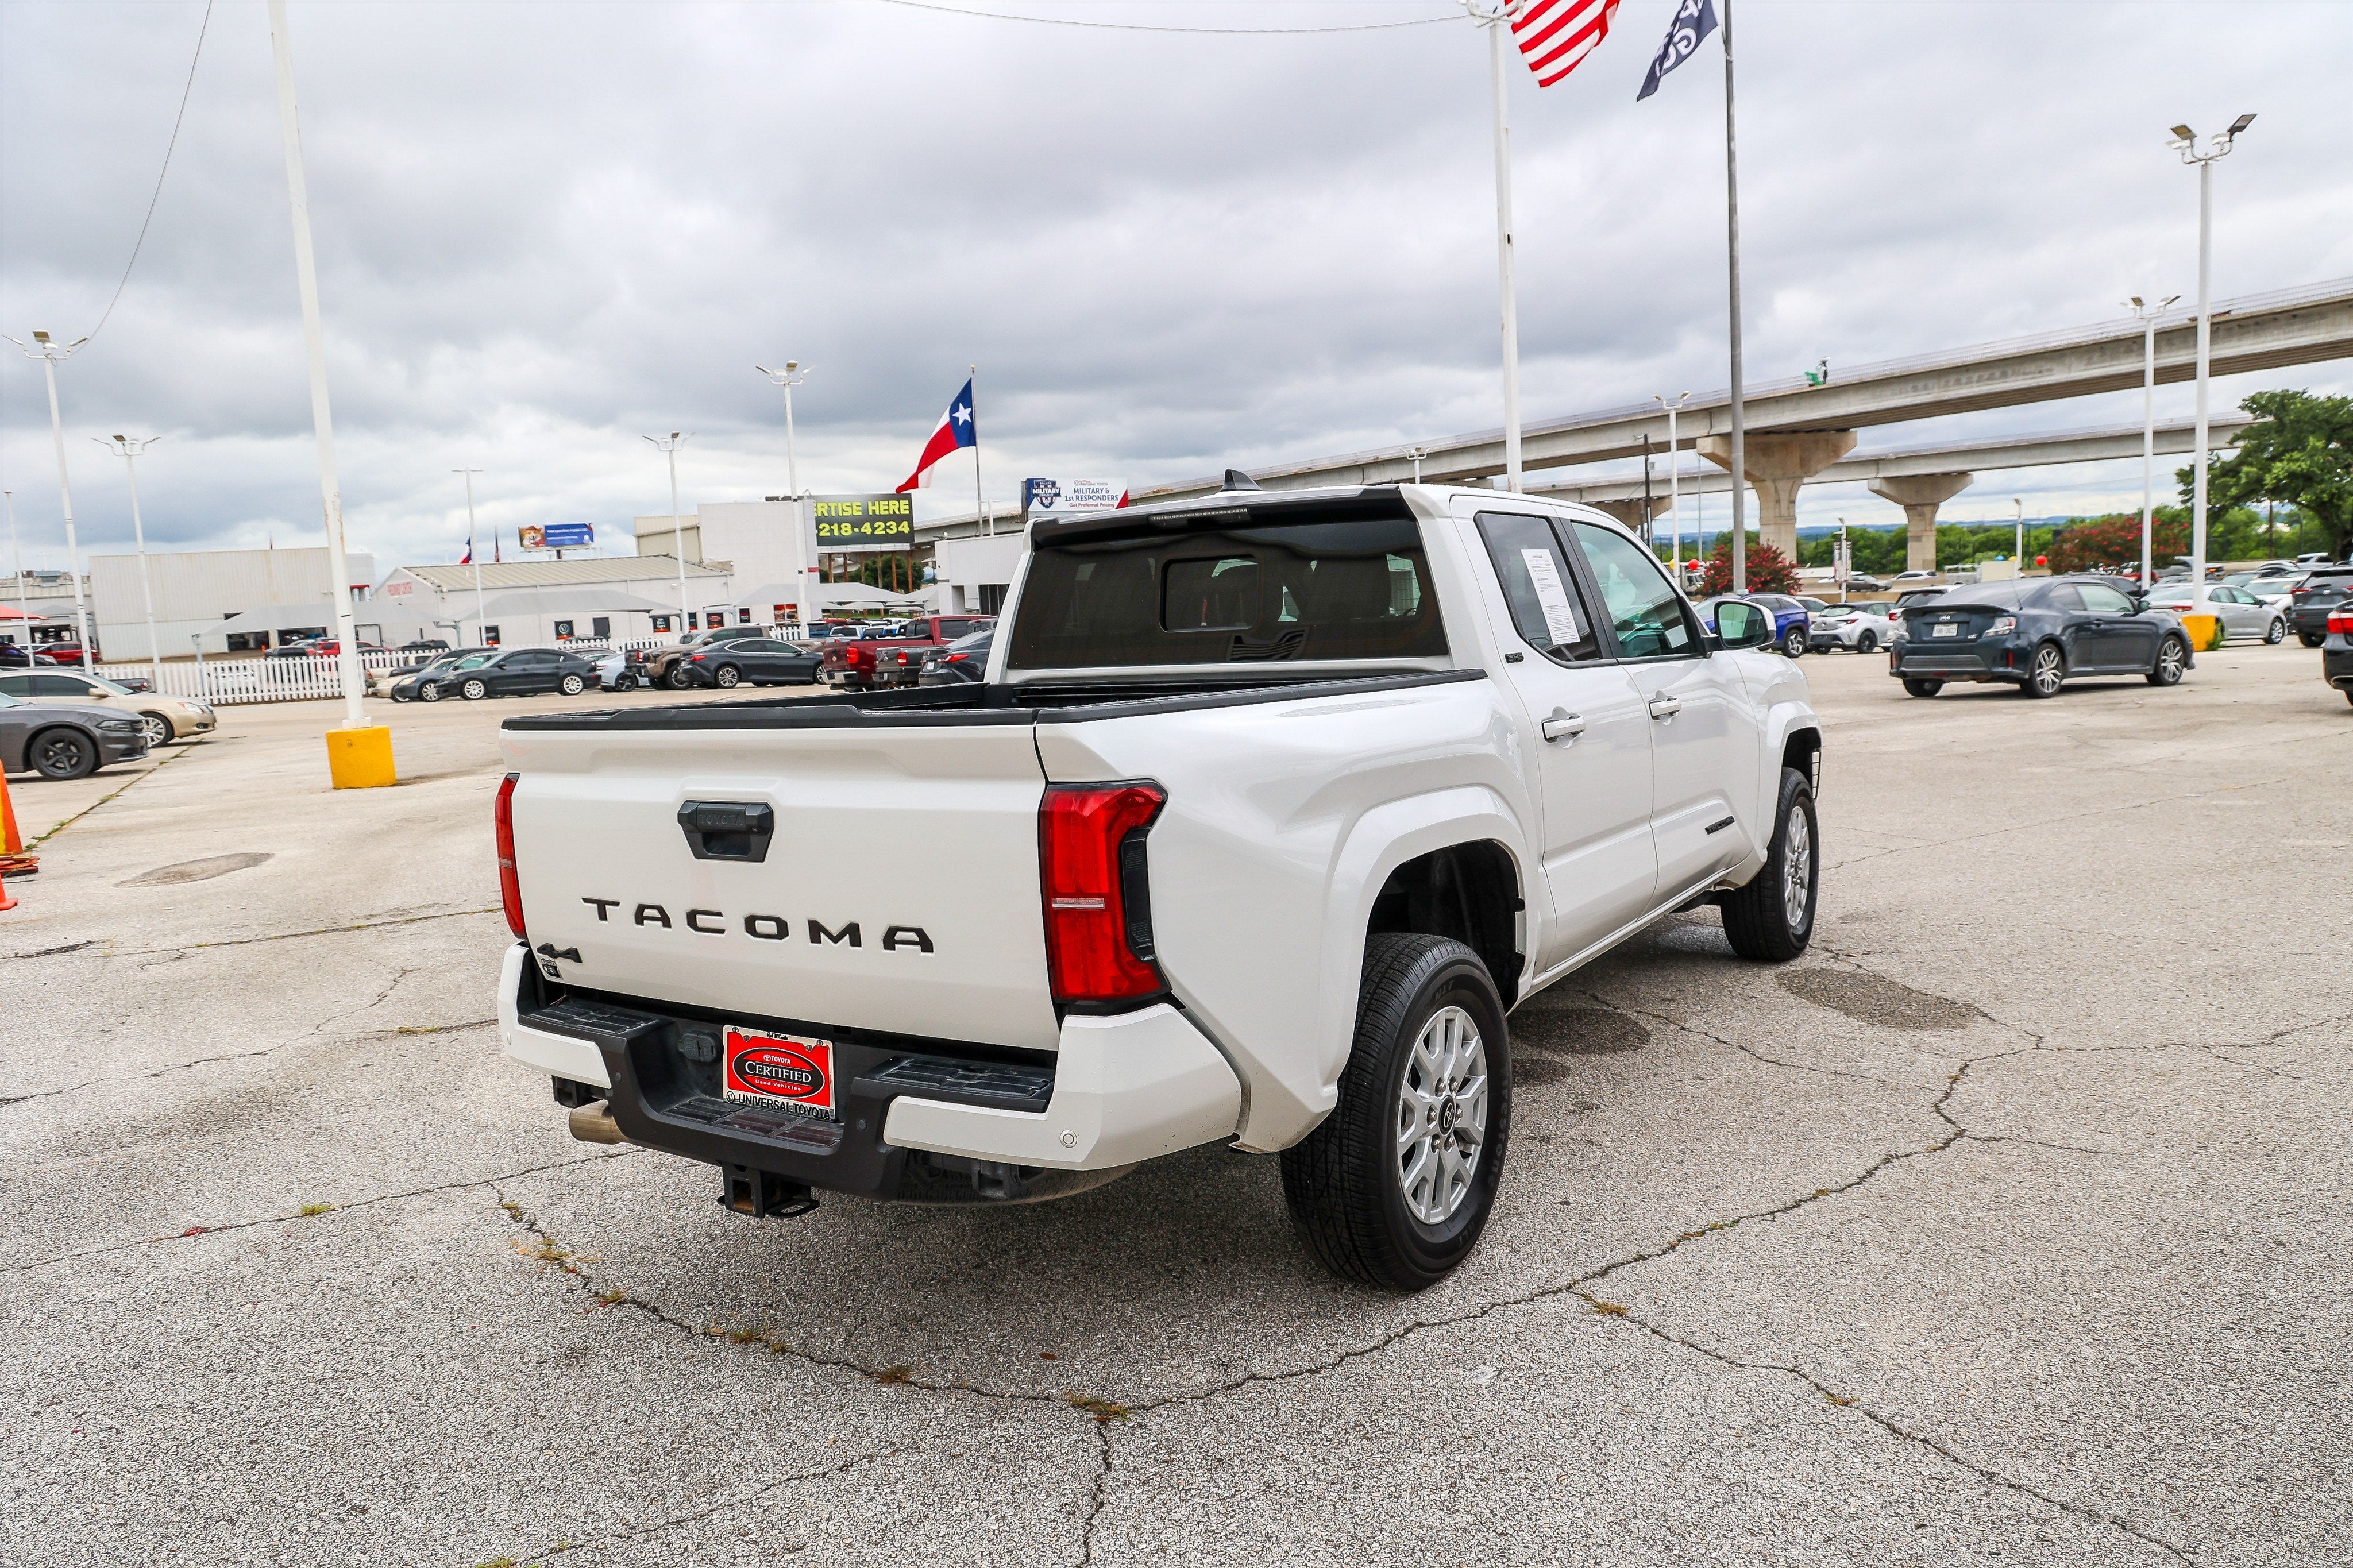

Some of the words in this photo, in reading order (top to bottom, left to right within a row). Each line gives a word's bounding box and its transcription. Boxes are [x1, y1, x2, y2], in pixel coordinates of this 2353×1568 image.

[867, 500, 910, 515] HERE
[699, 813, 745, 825] TOYOTA
[581, 897, 934, 953] TACOMA
[771, 1056, 791, 1064] TOYOTA
[745, 1061, 811, 1082] CERTIFIED
[773, 1082, 801, 1091] Vehicles
[738, 1093, 793, 1113] UNIVERSAL
[793, 1103, 831, 1120] TOYOTA
